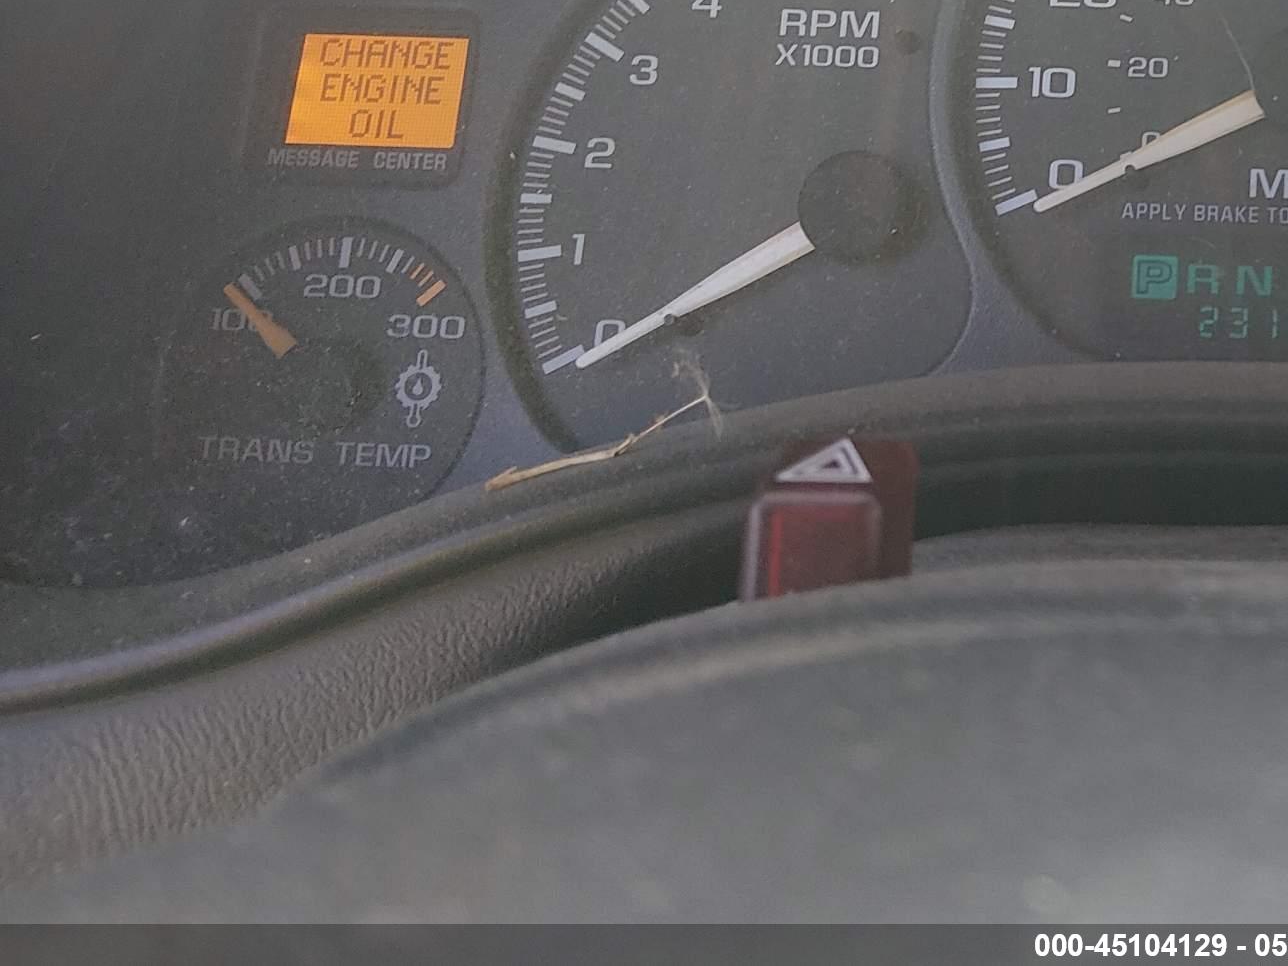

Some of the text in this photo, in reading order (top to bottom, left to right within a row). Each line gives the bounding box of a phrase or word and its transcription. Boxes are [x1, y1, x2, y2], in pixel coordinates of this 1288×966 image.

[778, 9, 880, 39] RPM
[319, 38, 456, 70] CHANGE
[775, 45, 879, 68] X1000
[1127, 57, 1169, 78] 20
[629, 55, 658, 85] 3
[1029, 68, 1076, 97] 10
[319, 75, 444, 105] ENGINE
[349, 109, 404, 139] OIL
[267, 148, 447, 171] MESSAGE CENTER
[584, 138, 615, 169] 2
[1049, 159, 1084, 190] 0
[1121, 202, 1185, 221] APPLY
[1193, 204, 1259, 224] BRAKE
[572, 233, 587, 265] 1
[304, 274, 382, 299] 200
[1136, 260, 1173, 294] P
[1187, 264, 1219, 295] R
[1235, 266, 1273, 296] N
[210, 306, 273, 332] 10
[387, 314, 466, 340] 300
[199, 437, 431, 469] TRANS TEMP
